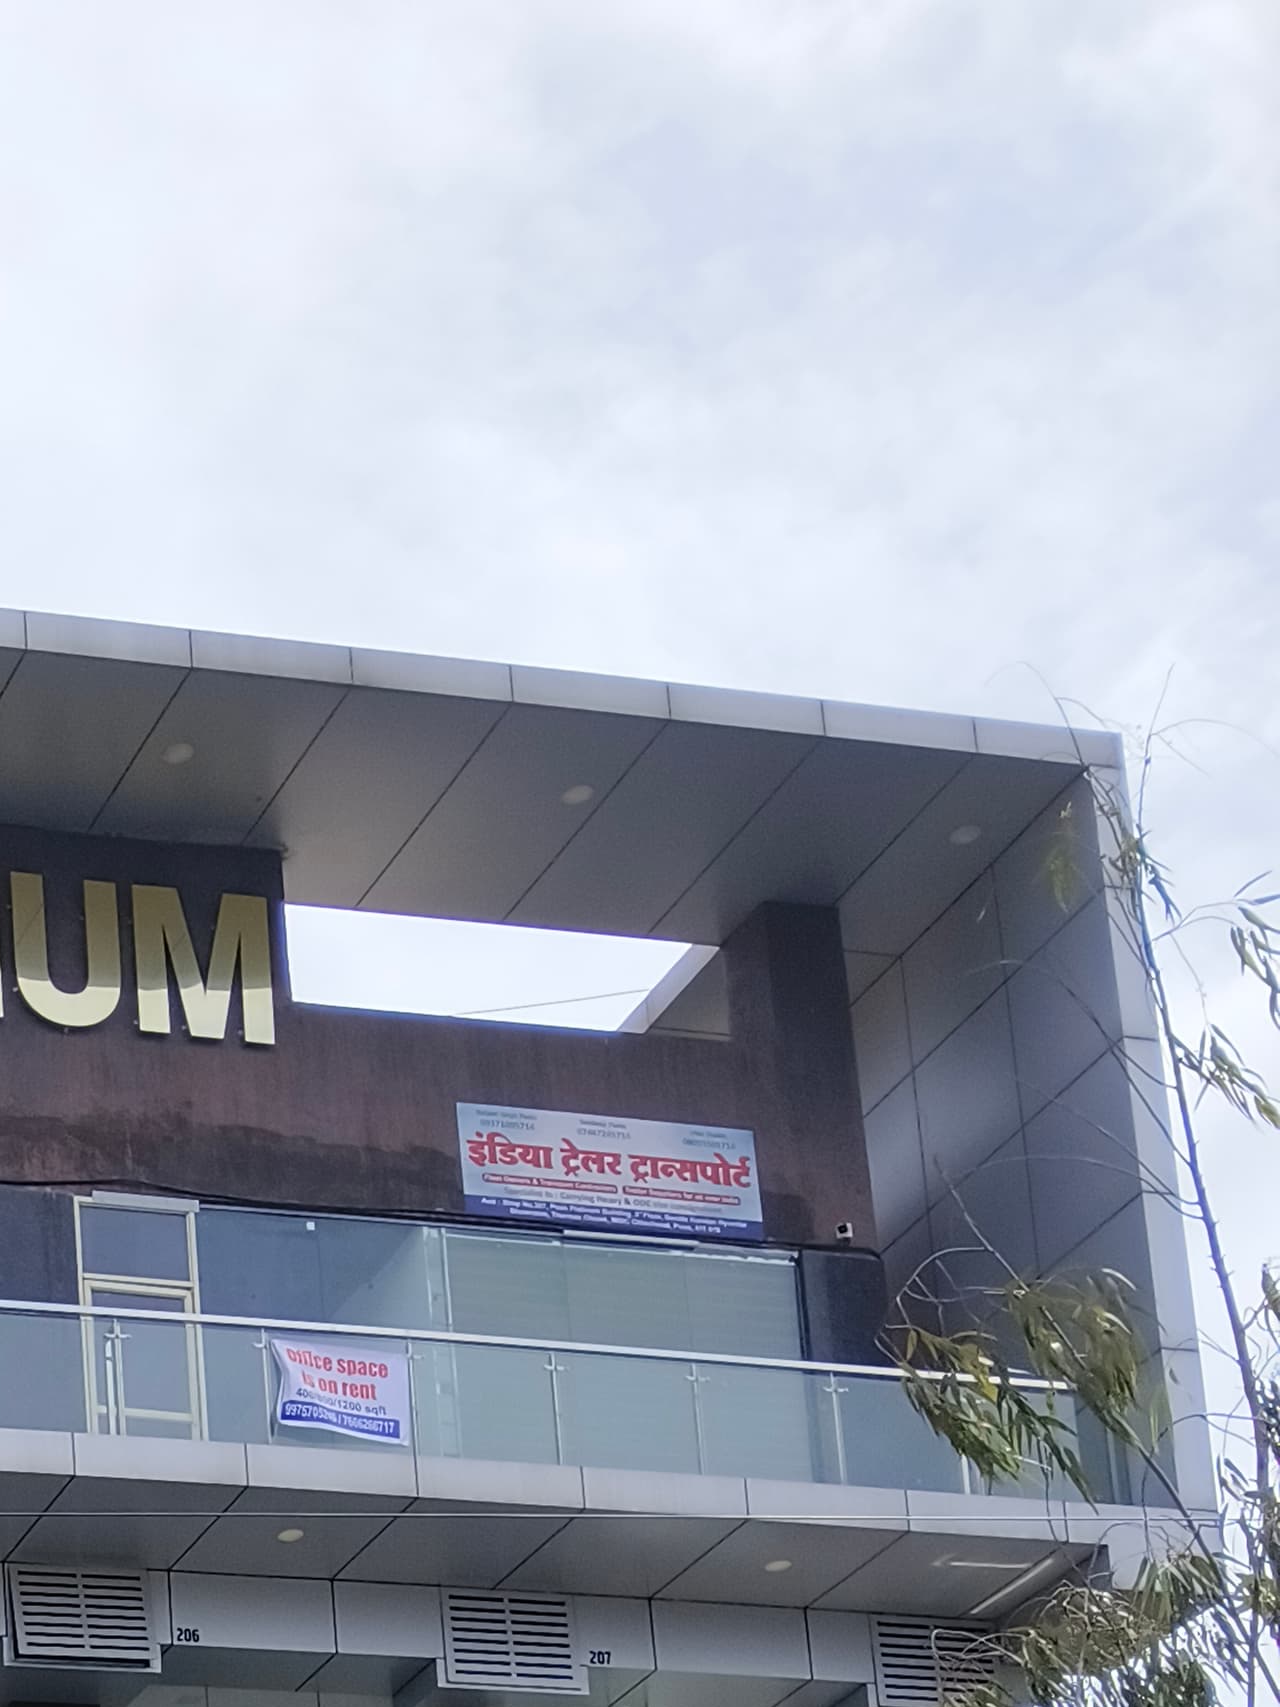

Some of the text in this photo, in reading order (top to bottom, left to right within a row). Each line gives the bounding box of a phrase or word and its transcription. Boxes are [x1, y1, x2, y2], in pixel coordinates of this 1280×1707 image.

[466, 1131, 553, 1169] इंडिया
[560, 1138, 622, 1177] ट्रेलर
[628, 1152, 752, 1188] ट्रान्सपोर्ट
[336, 1358, 389, 1379] space
[318, 1378, 338, 1395] on
[341, 1382, 377, 1400] rent
[176, 1626, 200, 1644] 206
[588, 1650, 613, 1667] 207
